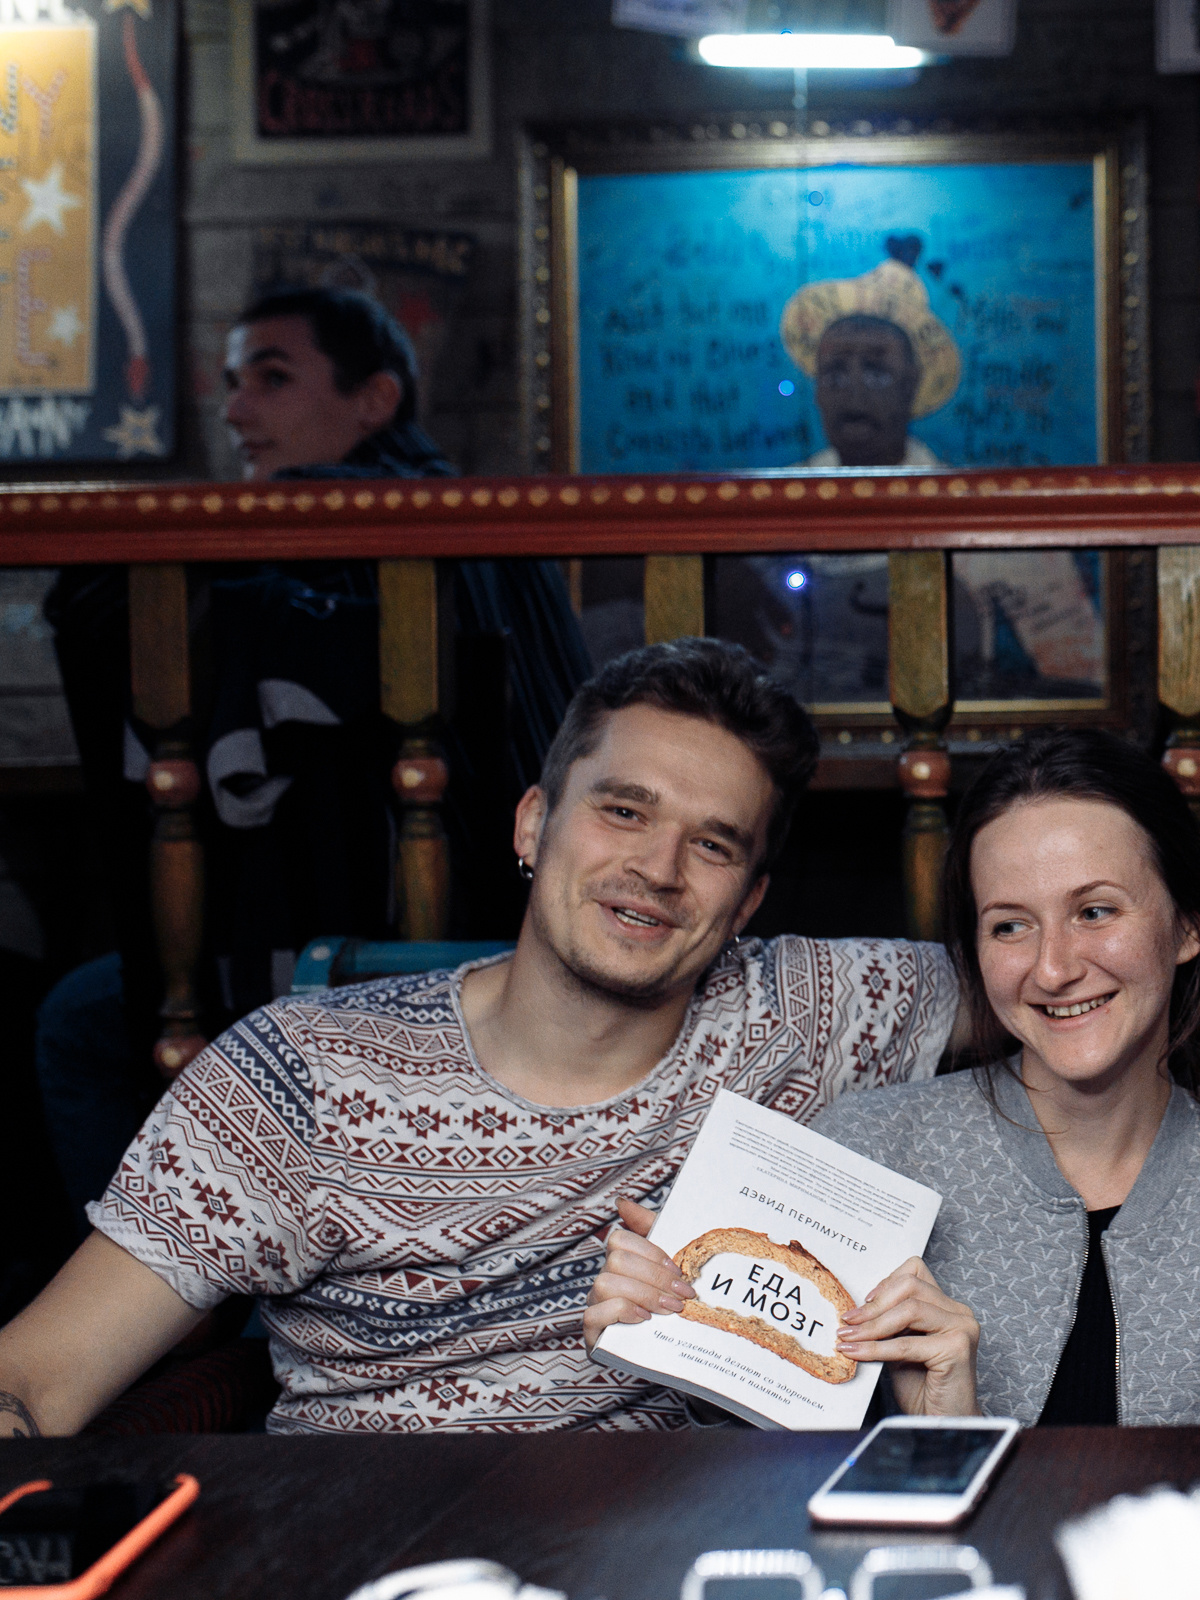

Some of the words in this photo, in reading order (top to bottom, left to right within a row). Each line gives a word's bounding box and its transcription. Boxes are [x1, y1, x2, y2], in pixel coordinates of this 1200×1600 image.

[739, 1185, 785, 1213] ДЭВИД
[788, 1208, 868, 1253] ПЕРЛМУТТЕР
[710, 1273, 734, 1296] И
[741, 1287, 824, 1338] МОЗГ
[747, 1263, 803, 1306] ЕДА
[653, 1330, 675, 1344] Что
[677, 1339, 723, 1361] углеводы
[725, 1355, 762, 1379] делают
[763, 1376, 775, 1386] со
[678, 1351, 738, 1379] мышлением
[739, 1374, 746, 1382] и
[747, 1380, 792, 1406] памятью
